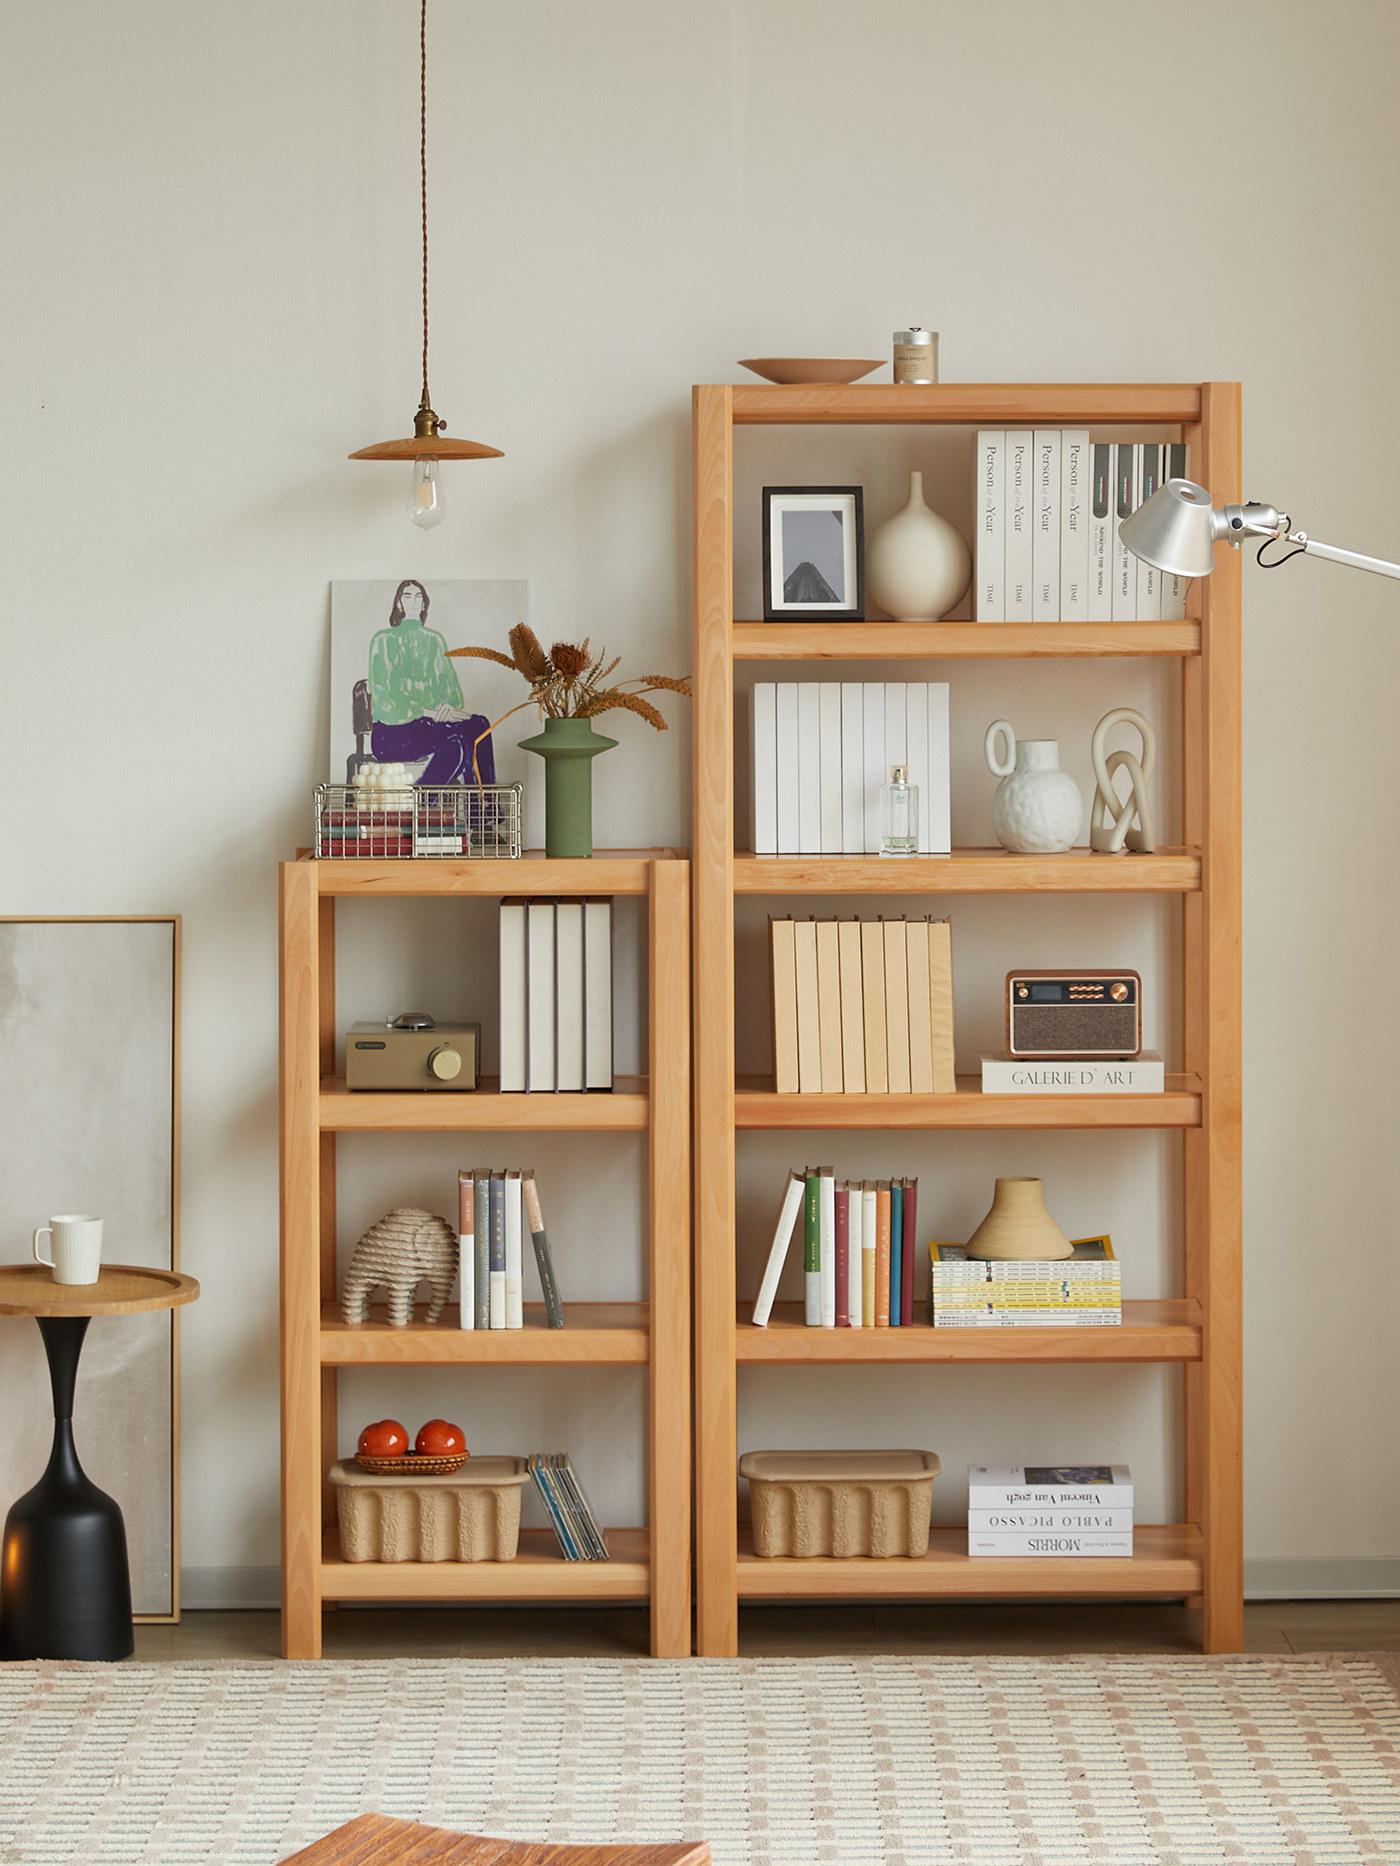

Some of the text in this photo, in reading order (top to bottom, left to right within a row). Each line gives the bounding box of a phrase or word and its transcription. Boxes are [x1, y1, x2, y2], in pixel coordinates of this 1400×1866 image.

[986, 447, 997, 488] Person
[1014, 446, 1025, 487] Person
[1042, 446, 1053, 487] Person
[1070, 445, 1081, 486] Person
[986, 506, 996, 533] Year
[1014, 506, 1025, 533] Year
[1041, 506, 1052, 532] Year
[1069, 505, 1080, 532] Year
[1011, 1071, 1076, 1086] GALERIE
[1103, 1071, 1136, 1086] ART
[1006, 1491, 1101, 1505] Vincent Van gogh
[989, 1516, 1113, 1527] PABLO PICASSO
[1028, 1538, 1081, 1552] MORRIS
